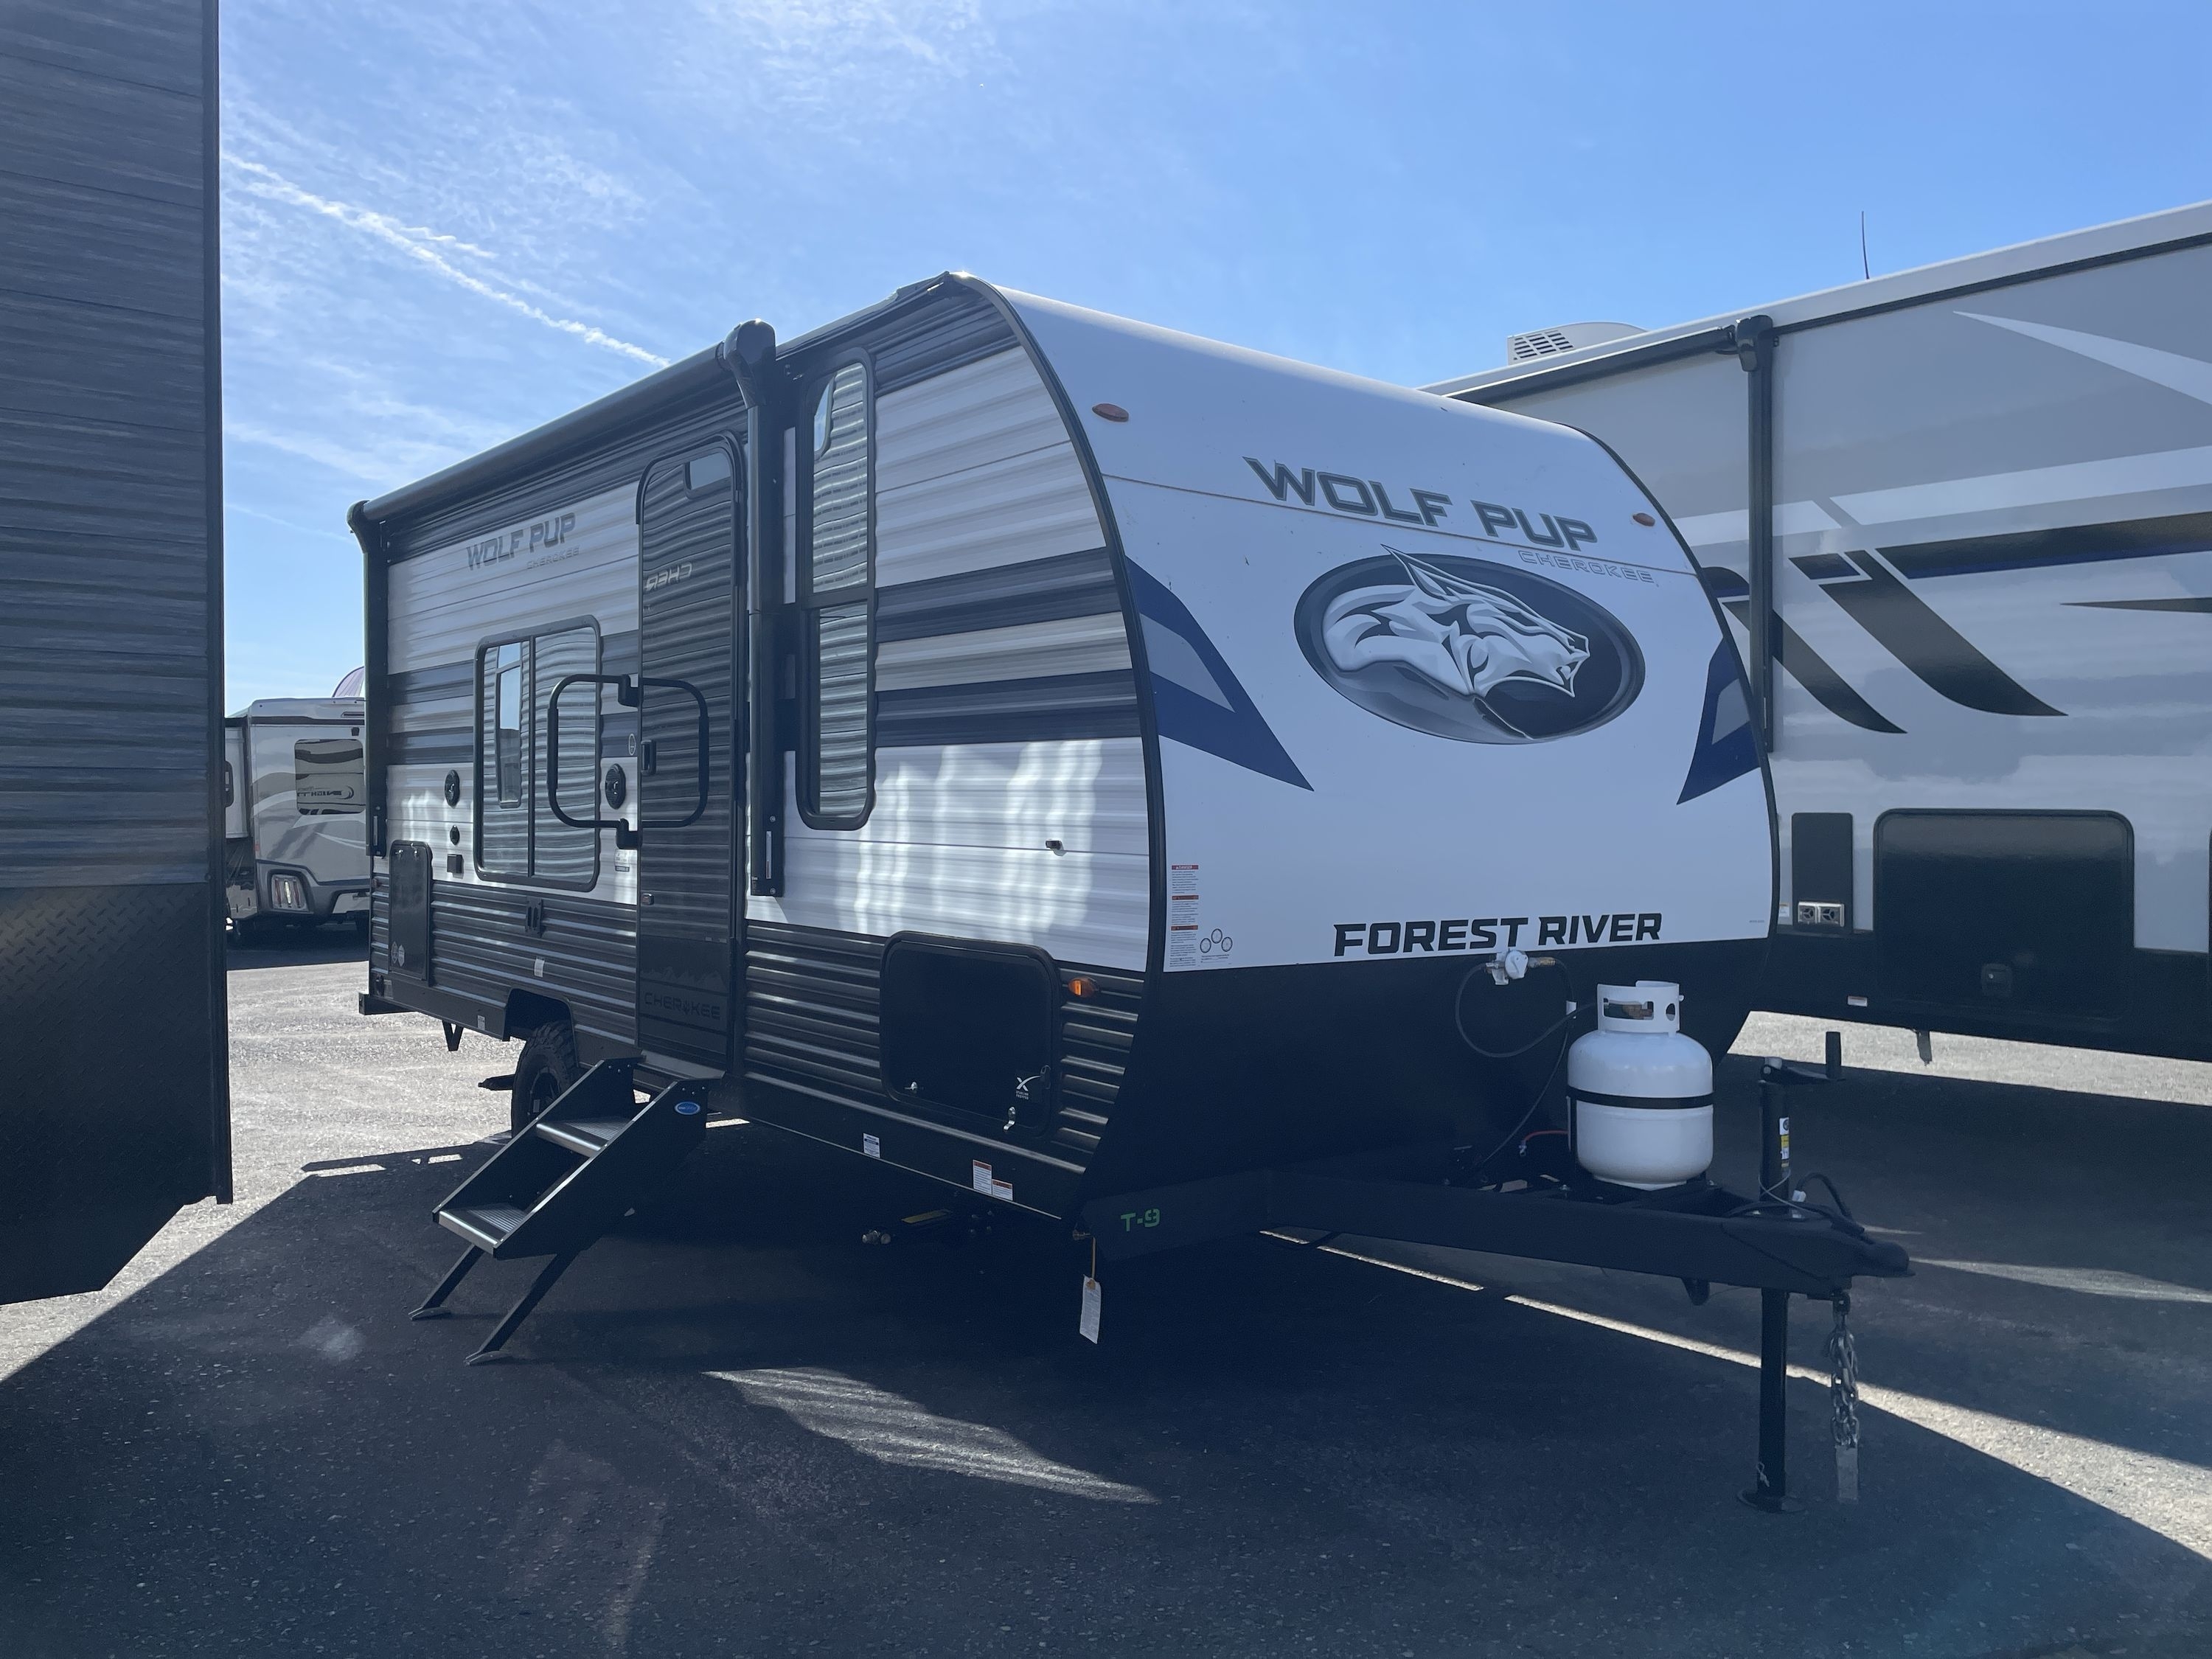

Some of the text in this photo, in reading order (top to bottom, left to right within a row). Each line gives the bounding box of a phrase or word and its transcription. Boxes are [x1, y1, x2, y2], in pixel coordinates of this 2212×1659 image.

[1242, 456, 1597, 551] WOLF PUP
[466, 512, 576, 571] WOLF PUP
[526, 546, 580, 570] CHEROKEE
[1517, 550, 1655, 583] CHEROKEE
[1334, 913, 1662, 956] FOREST RIVER
[1120, 1208, 1161, 1231] T-9
